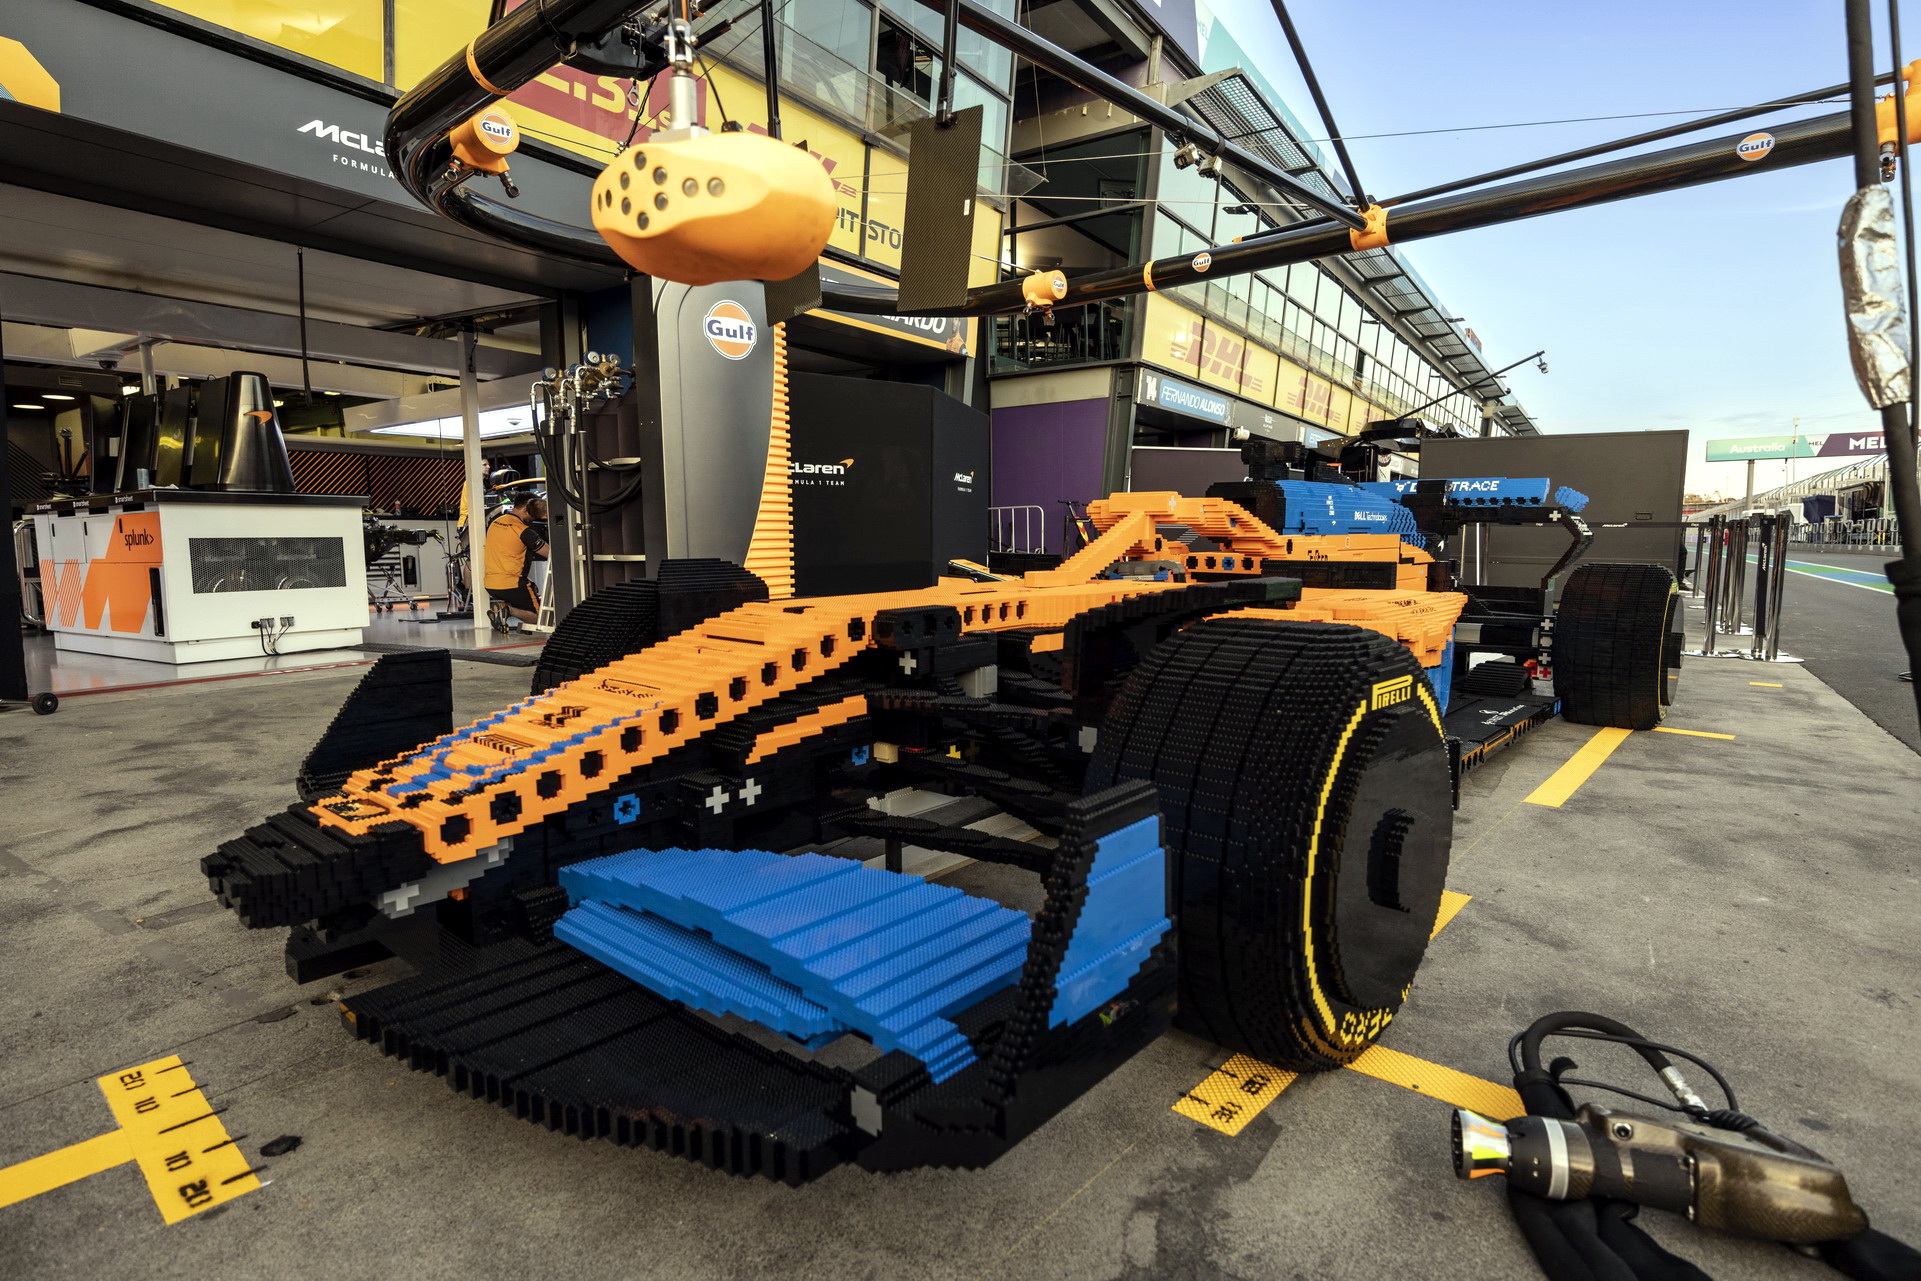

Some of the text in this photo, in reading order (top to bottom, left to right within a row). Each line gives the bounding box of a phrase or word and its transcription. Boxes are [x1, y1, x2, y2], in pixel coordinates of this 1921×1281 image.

[482, 121, 511, 138] Gulf
[1739, 139, 1773, 153] Gulf
[332, 154, 395, 179] FORMULA
[1193, 257, 1211, 267] Gulf
[707, 319, 754, 341] Gulf
[1183, 321, 1255, 391] DHL
[1161, 385, 1226, 417] FERNANDO ALONSO
[1300, 376, 1336, 421] DHL
[1729, 442, 1786, 454] Australia
[953, 472, 973, 484] McLaren
[1371, 674, 1413, 711] PIRELLI
[119, 1070, 147, 1091] 20
[134, 1096, 160, 1114] 10
[164, 1150, 193, 1172] 10
[178, 1178, 213, 1208] 20
